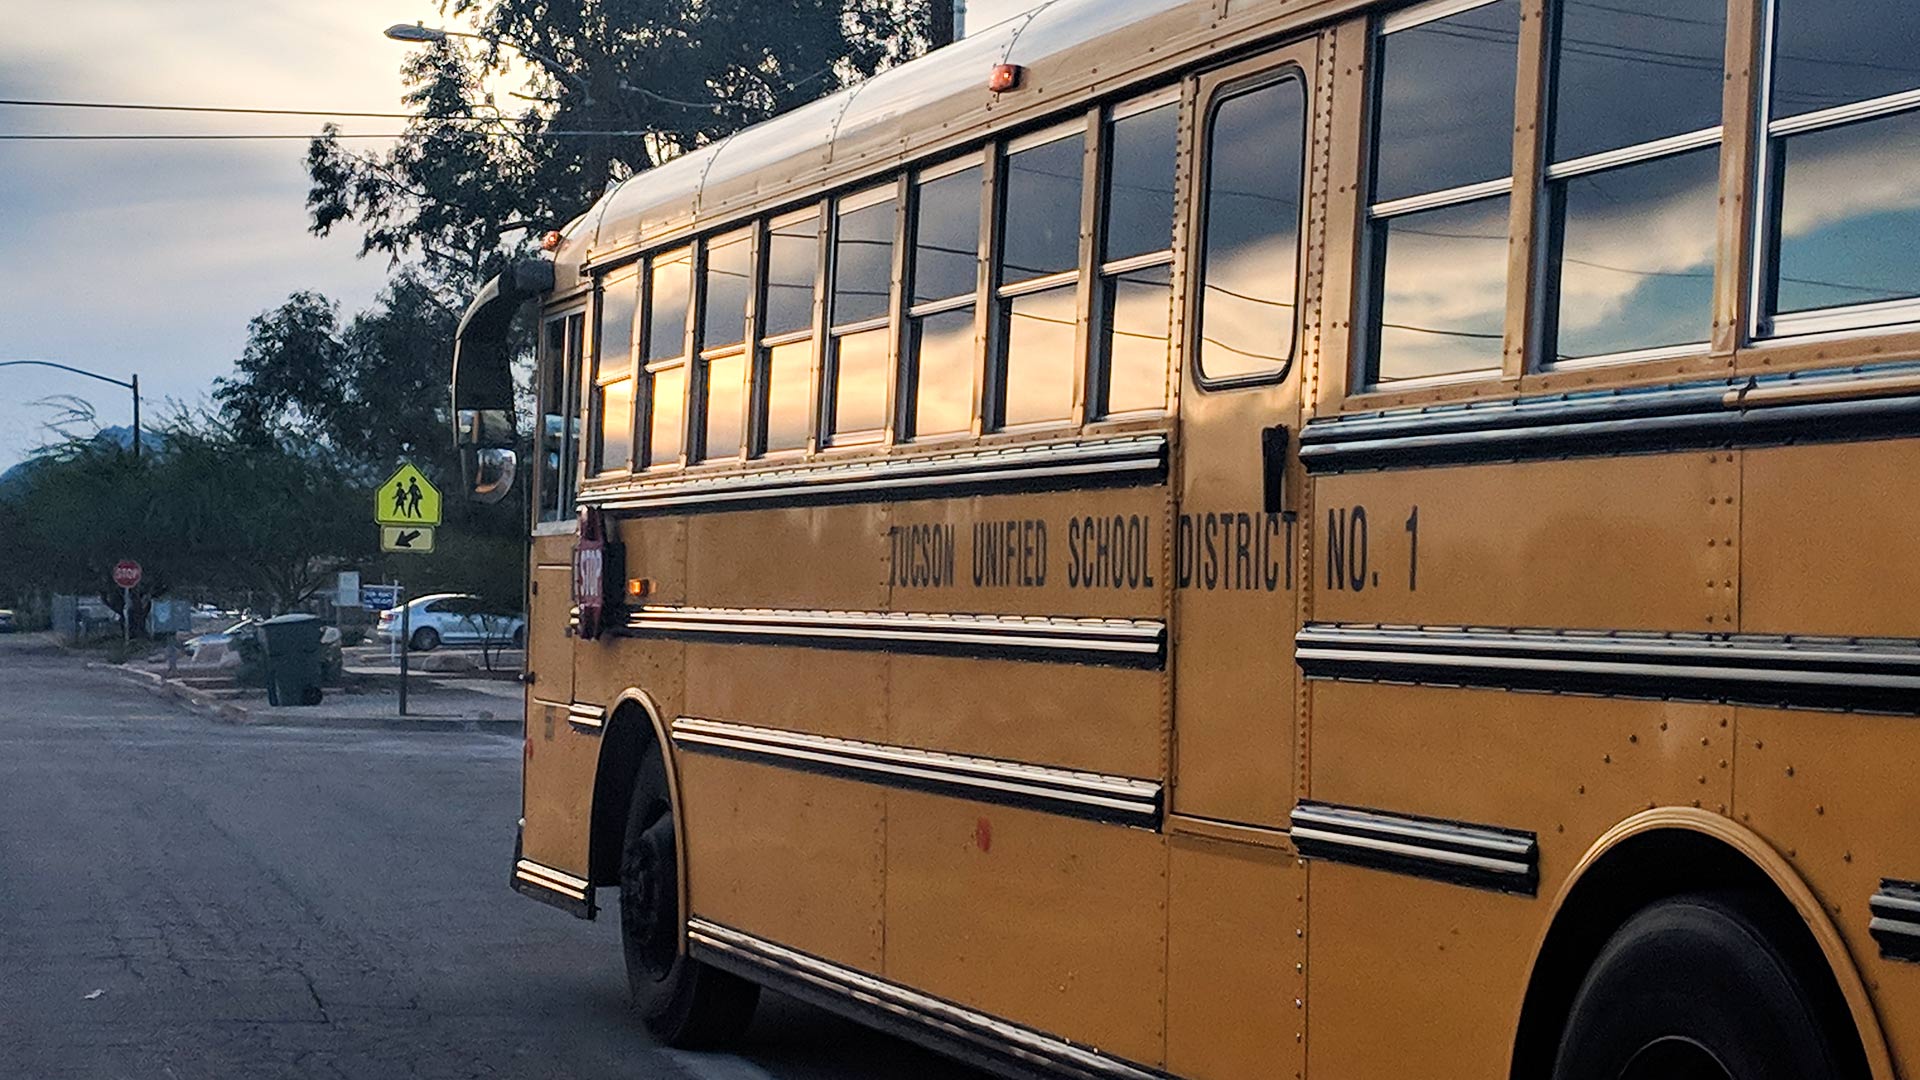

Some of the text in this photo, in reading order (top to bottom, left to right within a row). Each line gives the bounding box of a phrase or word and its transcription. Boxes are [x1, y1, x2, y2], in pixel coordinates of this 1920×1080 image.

[890, 504, 1418, 592] TUCSON UNIFIED SCHOOL DISTRICT NO. 1
[114, 567, 138, 579] STOP
[581, 550, 602, 596] STOP
